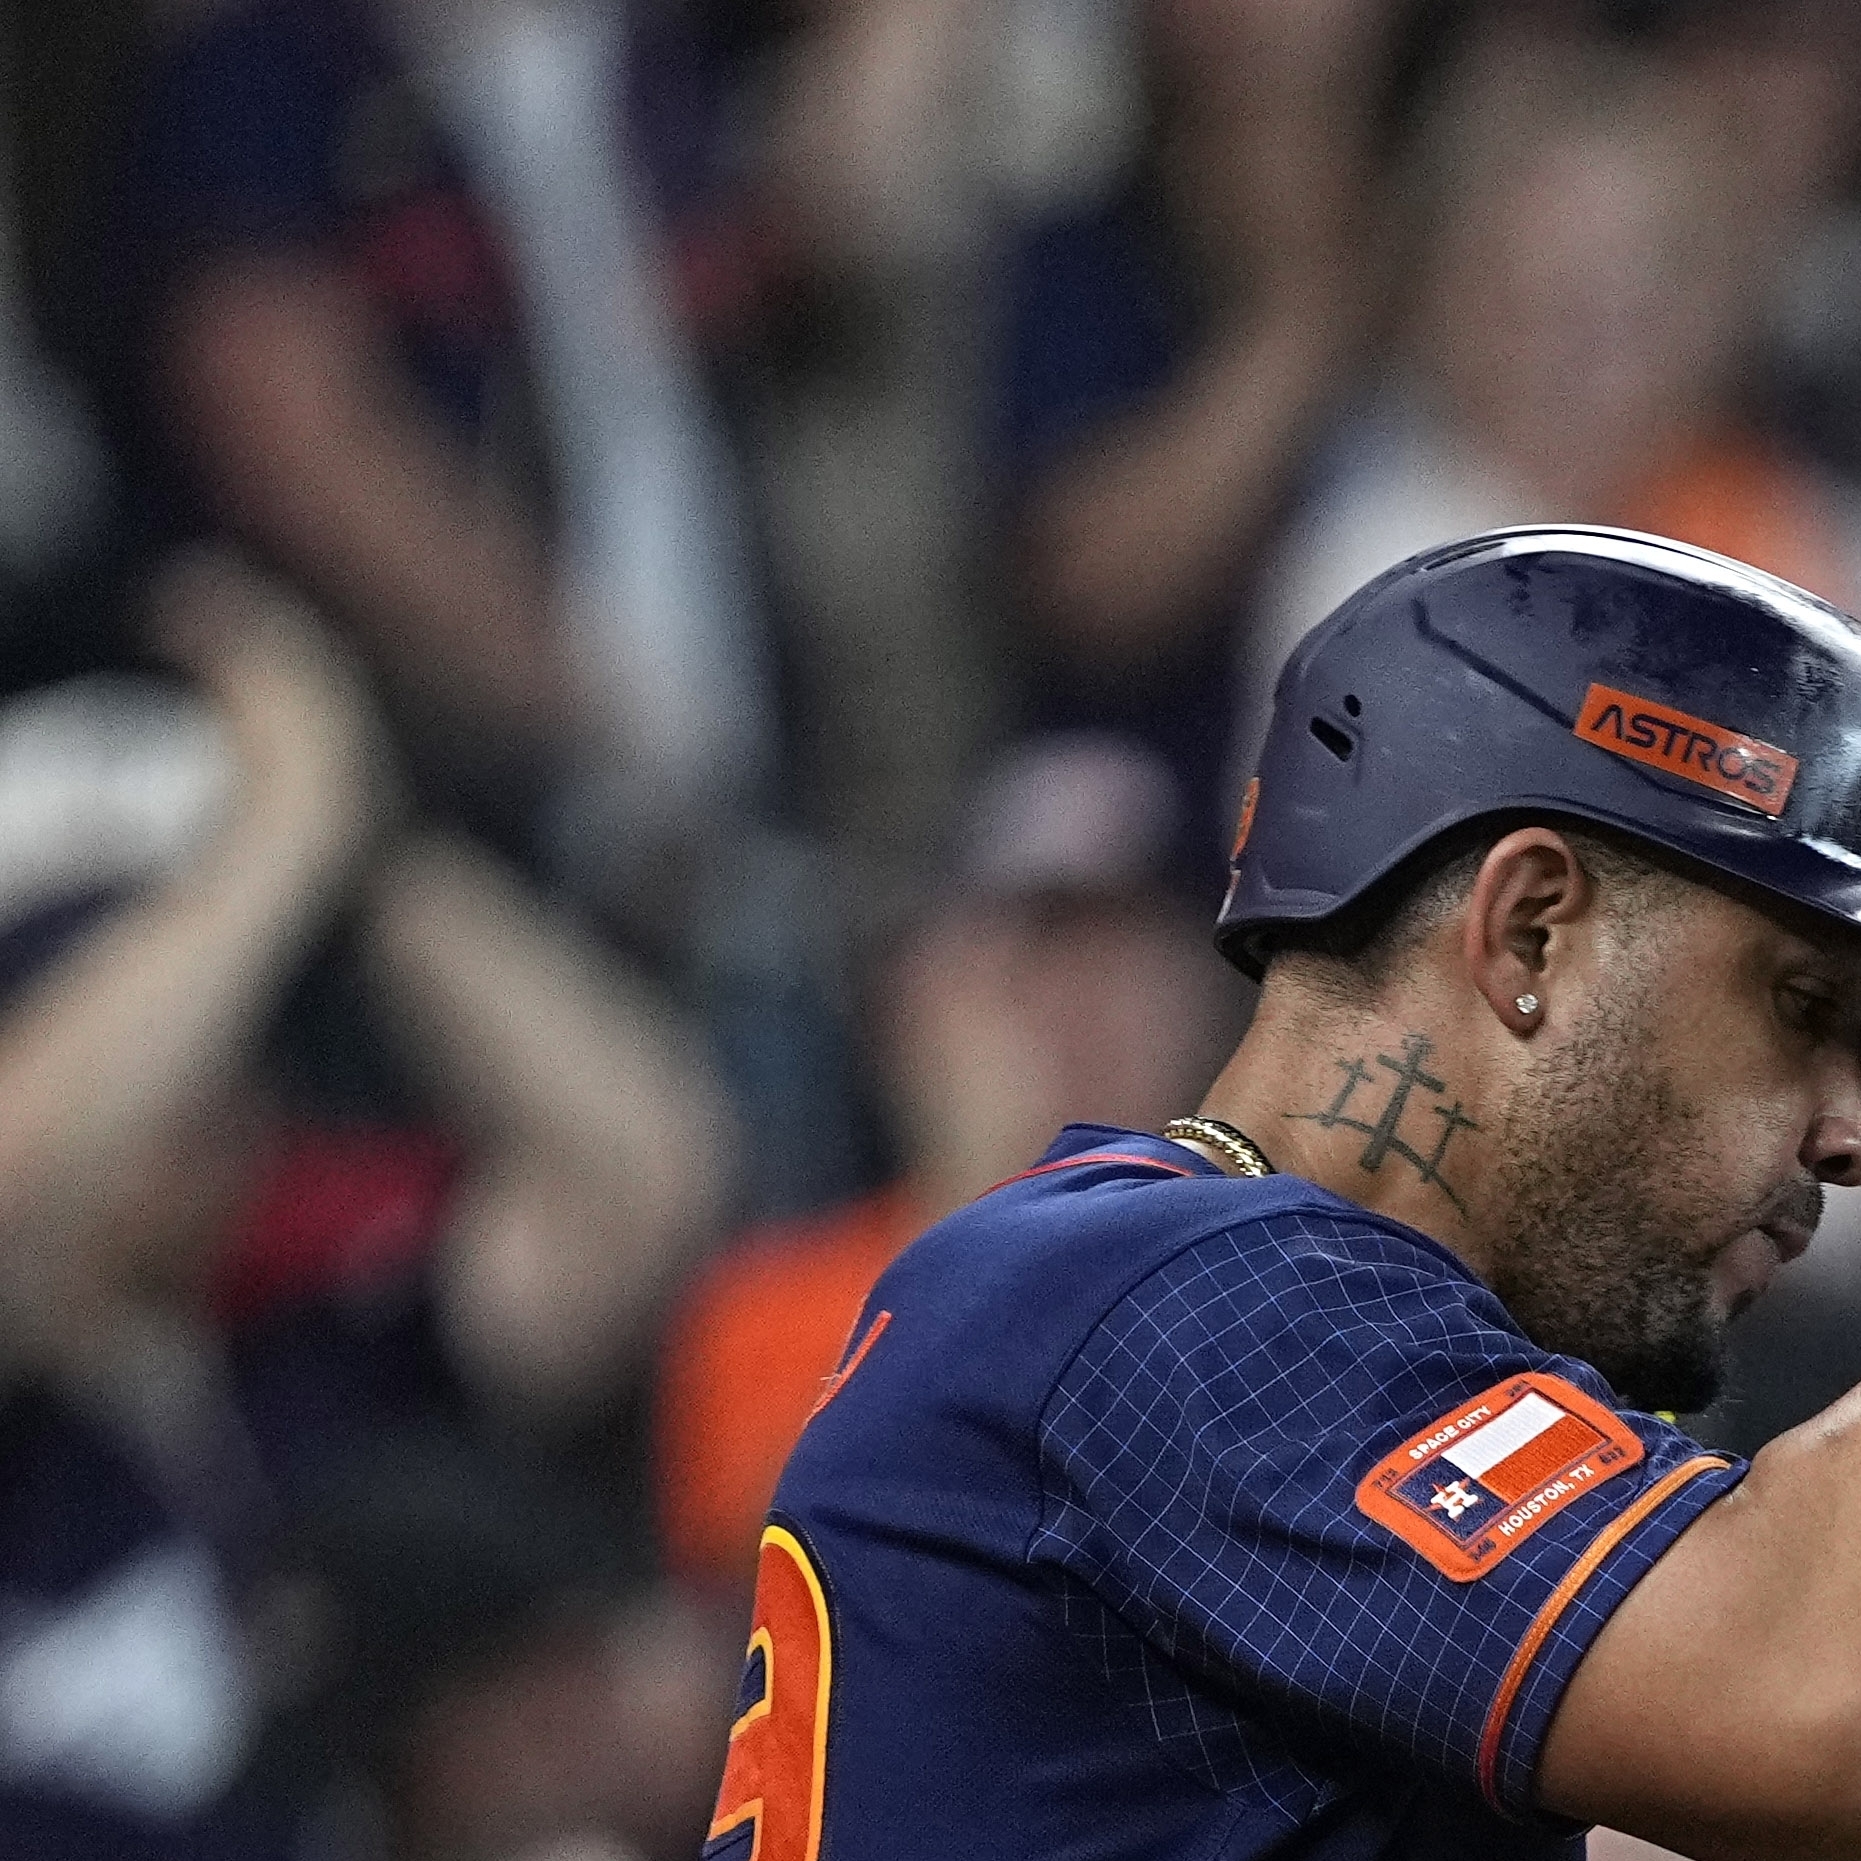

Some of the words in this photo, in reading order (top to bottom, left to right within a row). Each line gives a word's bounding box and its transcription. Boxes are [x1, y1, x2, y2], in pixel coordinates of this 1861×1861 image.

[1591, 703, 1782, 795] ASTROS
[1408, 1422, 1461, 1461] SPACE
[1459, 1405, 1493, 1431] CITY
[1497, 1478, 1577, 1537] HOUSTON,
[1568, 1463, 1596, 1487] TX
